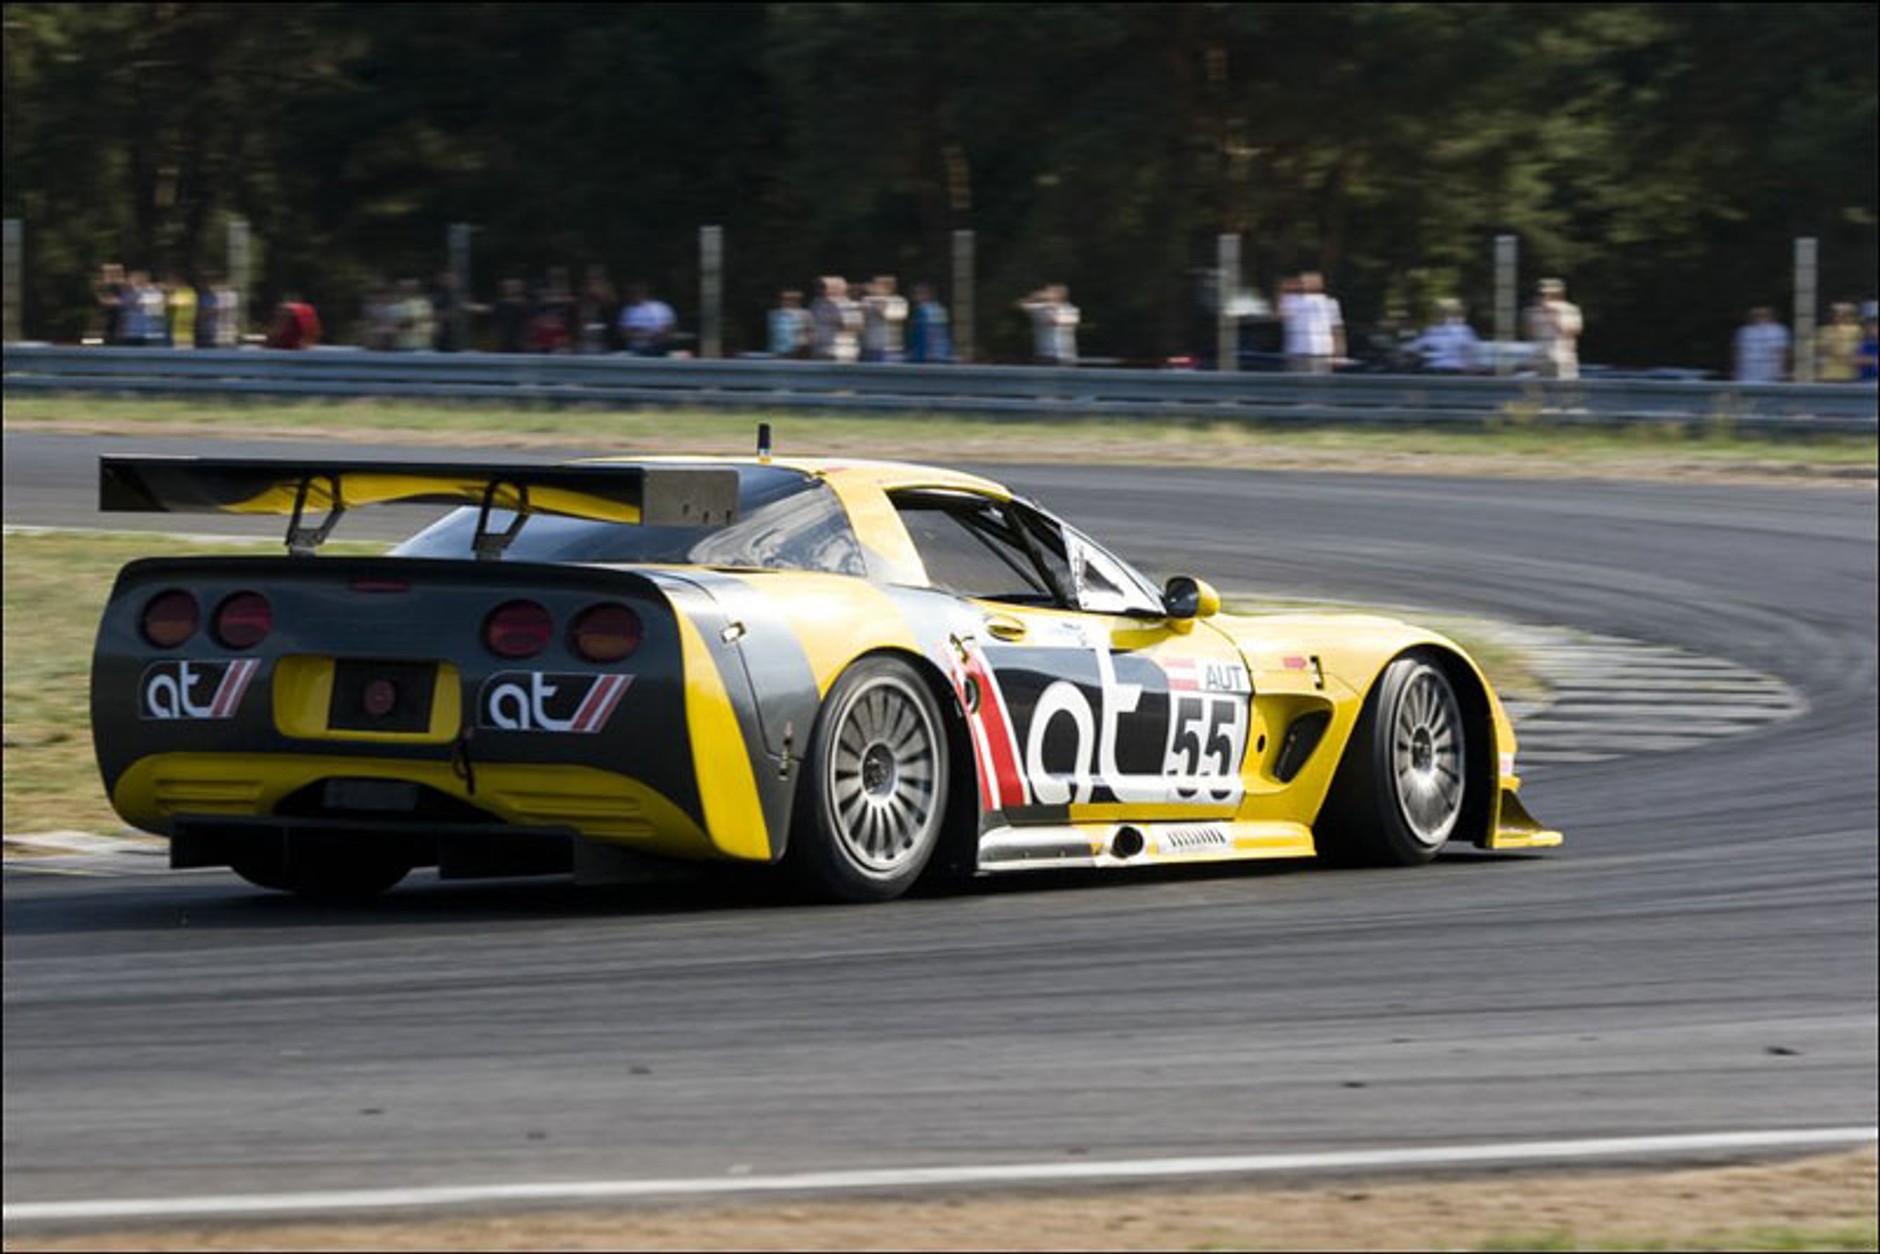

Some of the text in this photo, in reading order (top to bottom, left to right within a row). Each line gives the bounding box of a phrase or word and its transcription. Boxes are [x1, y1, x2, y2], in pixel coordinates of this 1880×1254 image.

[147, 660, 213, 718] at
[489, 671, 572, 732] at
[1205, 664, 1243, 690] AUT
[1027, 636, 1166, 804] at
[1167, 697, 1237, 801] 55
